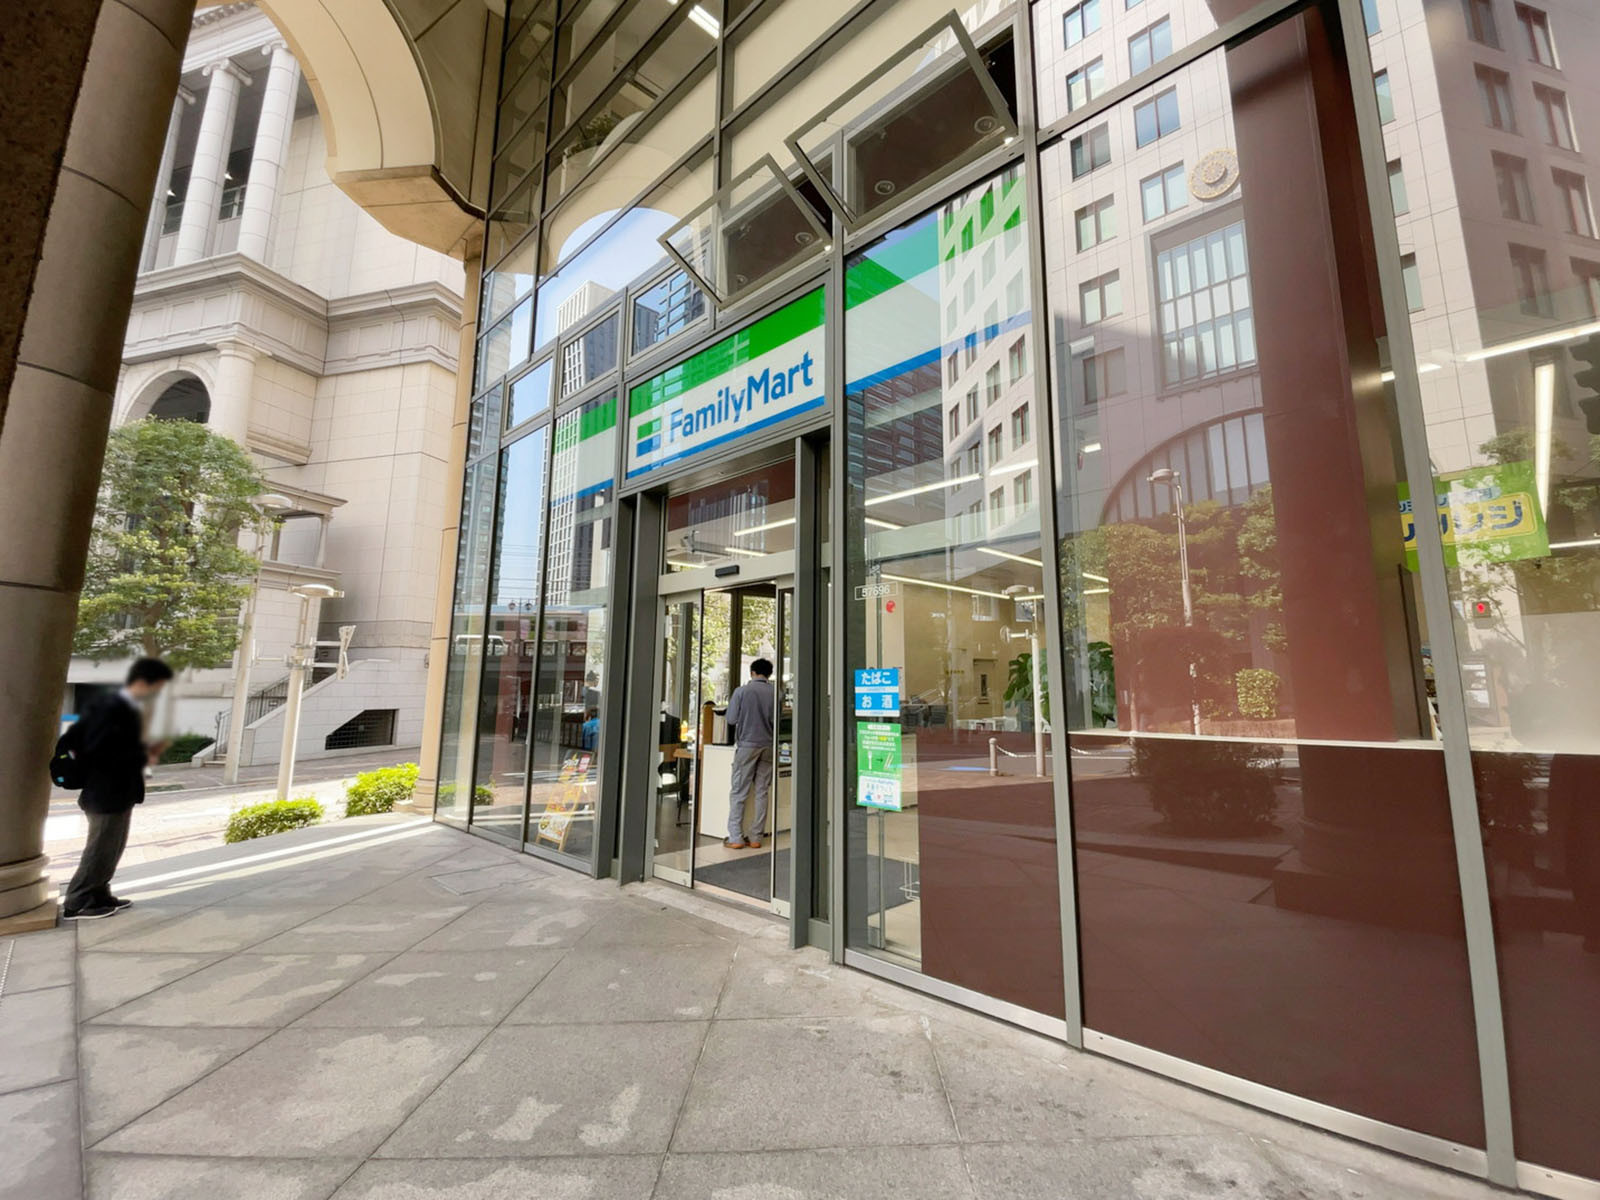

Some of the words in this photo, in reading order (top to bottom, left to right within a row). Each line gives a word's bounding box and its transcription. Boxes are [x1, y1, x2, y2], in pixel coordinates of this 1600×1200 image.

[670, 351, 814, 444] FamilyMart
[861, 583, 890, 598] 57696
[861, 670, 892, 686] たばこ
